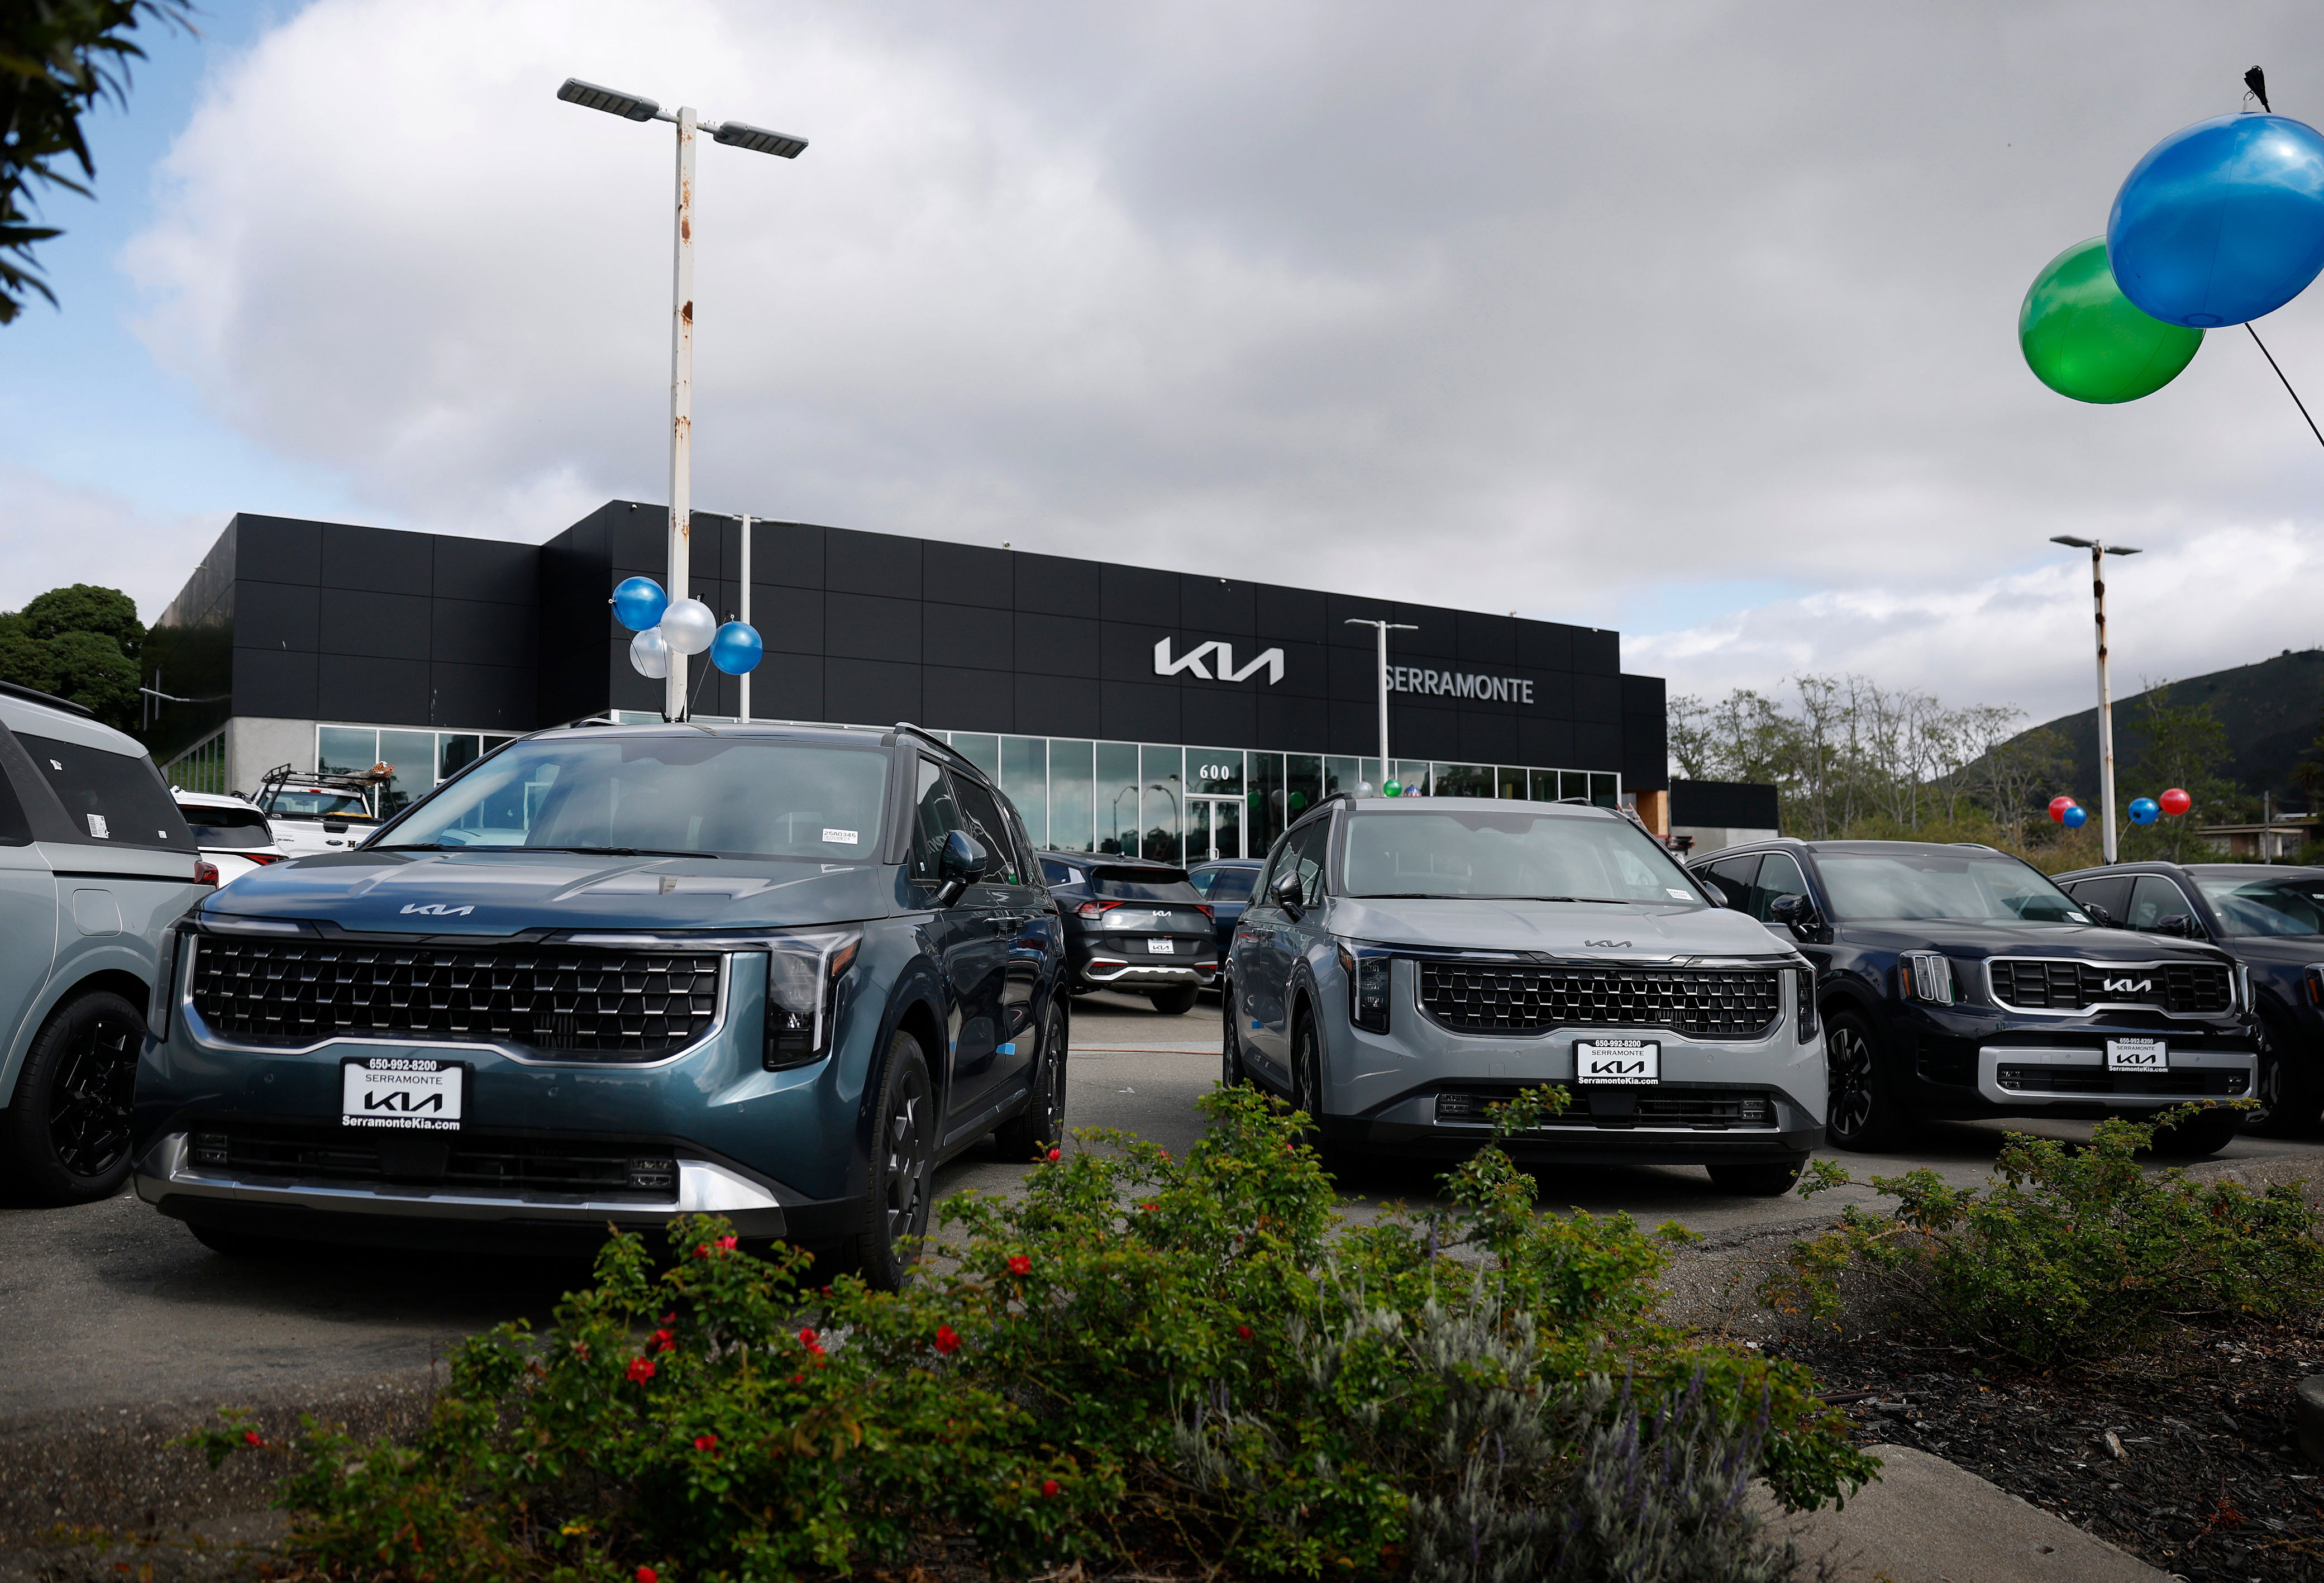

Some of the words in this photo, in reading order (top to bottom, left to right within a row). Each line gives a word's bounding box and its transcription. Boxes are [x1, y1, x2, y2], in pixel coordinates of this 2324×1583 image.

[1154, 636, 1284, 686] KIA
[1386, 664, 1534, 704] SERRAMONTE
[1200, 764, 1229, 780] 600
[399, 903, 475, 916] KIA
[2104, 979, 2151, 992] KIA
[369, 1058, 437, 1071] 650-992-8200
[2117, 1054, 2156, 1064] KIA
[1591, 1061, 1644, 1074] KIA
[365, 1074, 443, 1085] SERRAMONTE
[1578, 1076, 1658, 1085] SerramonteKia.com
[364, 1090, 442, 1113] KIA
[342, 1115, 460, 1131] SerramonteKia.com
